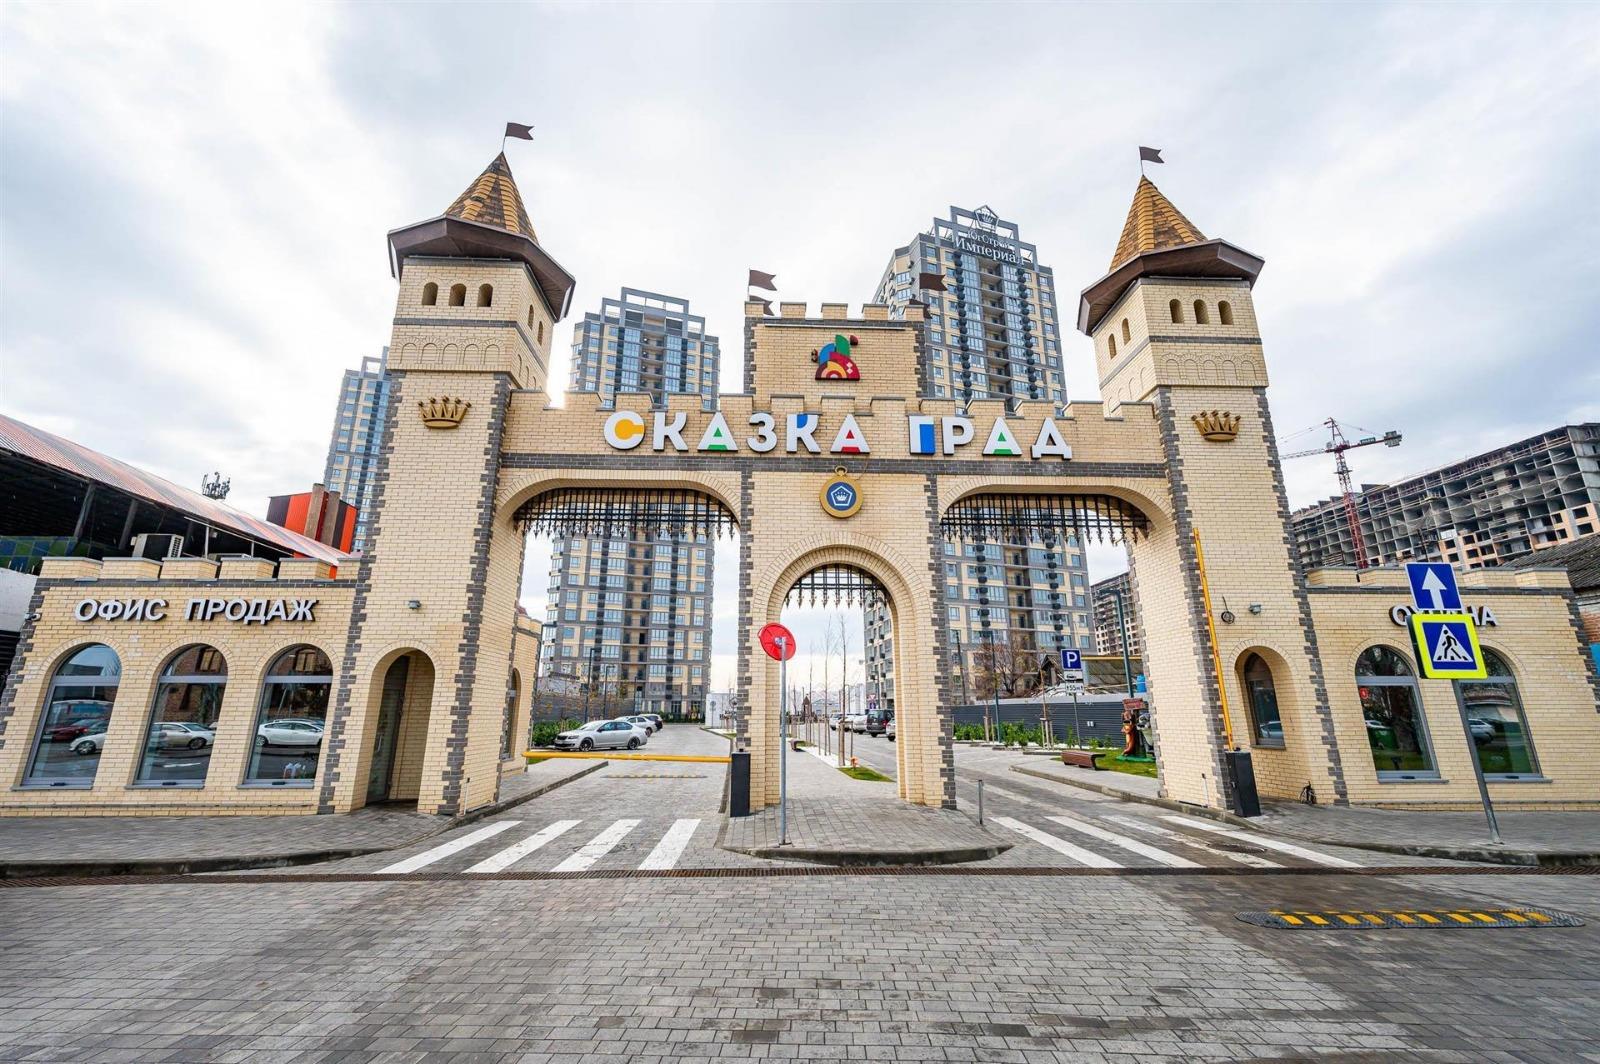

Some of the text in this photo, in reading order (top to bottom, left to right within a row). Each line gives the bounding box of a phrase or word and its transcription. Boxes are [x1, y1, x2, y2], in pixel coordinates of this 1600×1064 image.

[603, 410, 1073, 460] СКАЗКА ГРАД
[74, 599, 318, 625] ОФИС ПРОДАЖ
